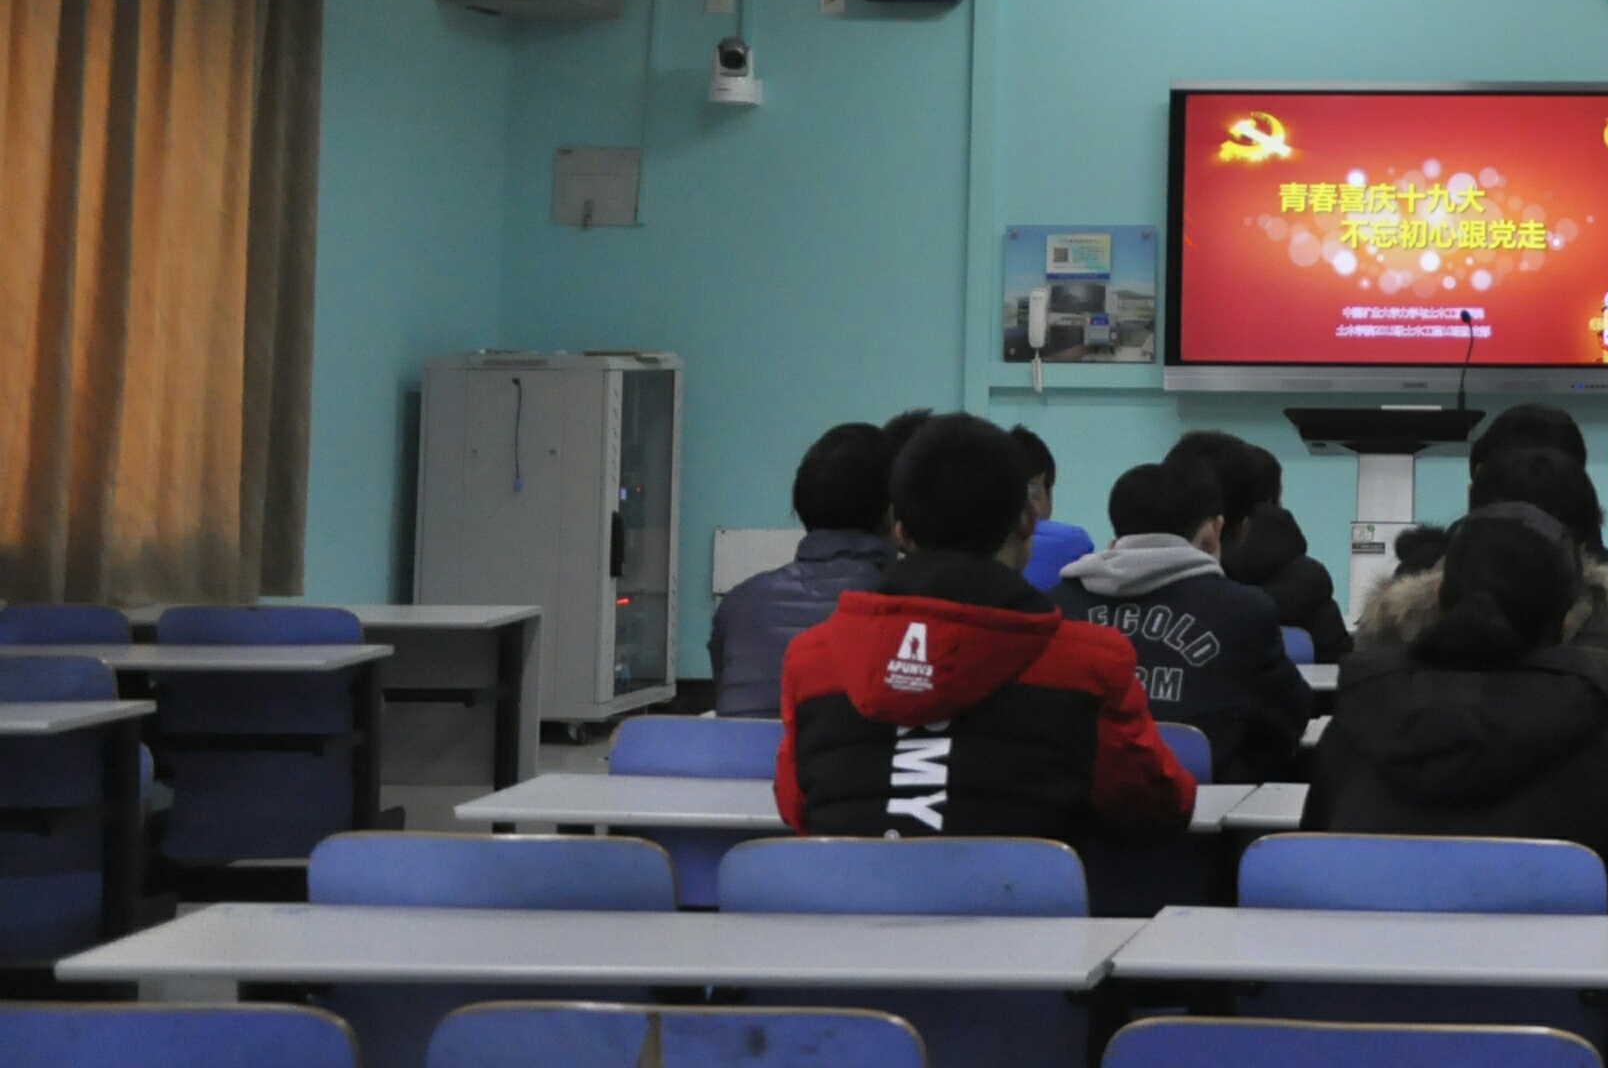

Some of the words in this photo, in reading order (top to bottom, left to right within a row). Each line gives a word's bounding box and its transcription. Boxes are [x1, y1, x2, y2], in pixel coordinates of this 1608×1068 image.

[1279, 183, 1485, 213] 青春喜庆十九大
[1341, 219, 1547, 249] 不忘初心跟党走
[886, 720, 952, 831] MY
